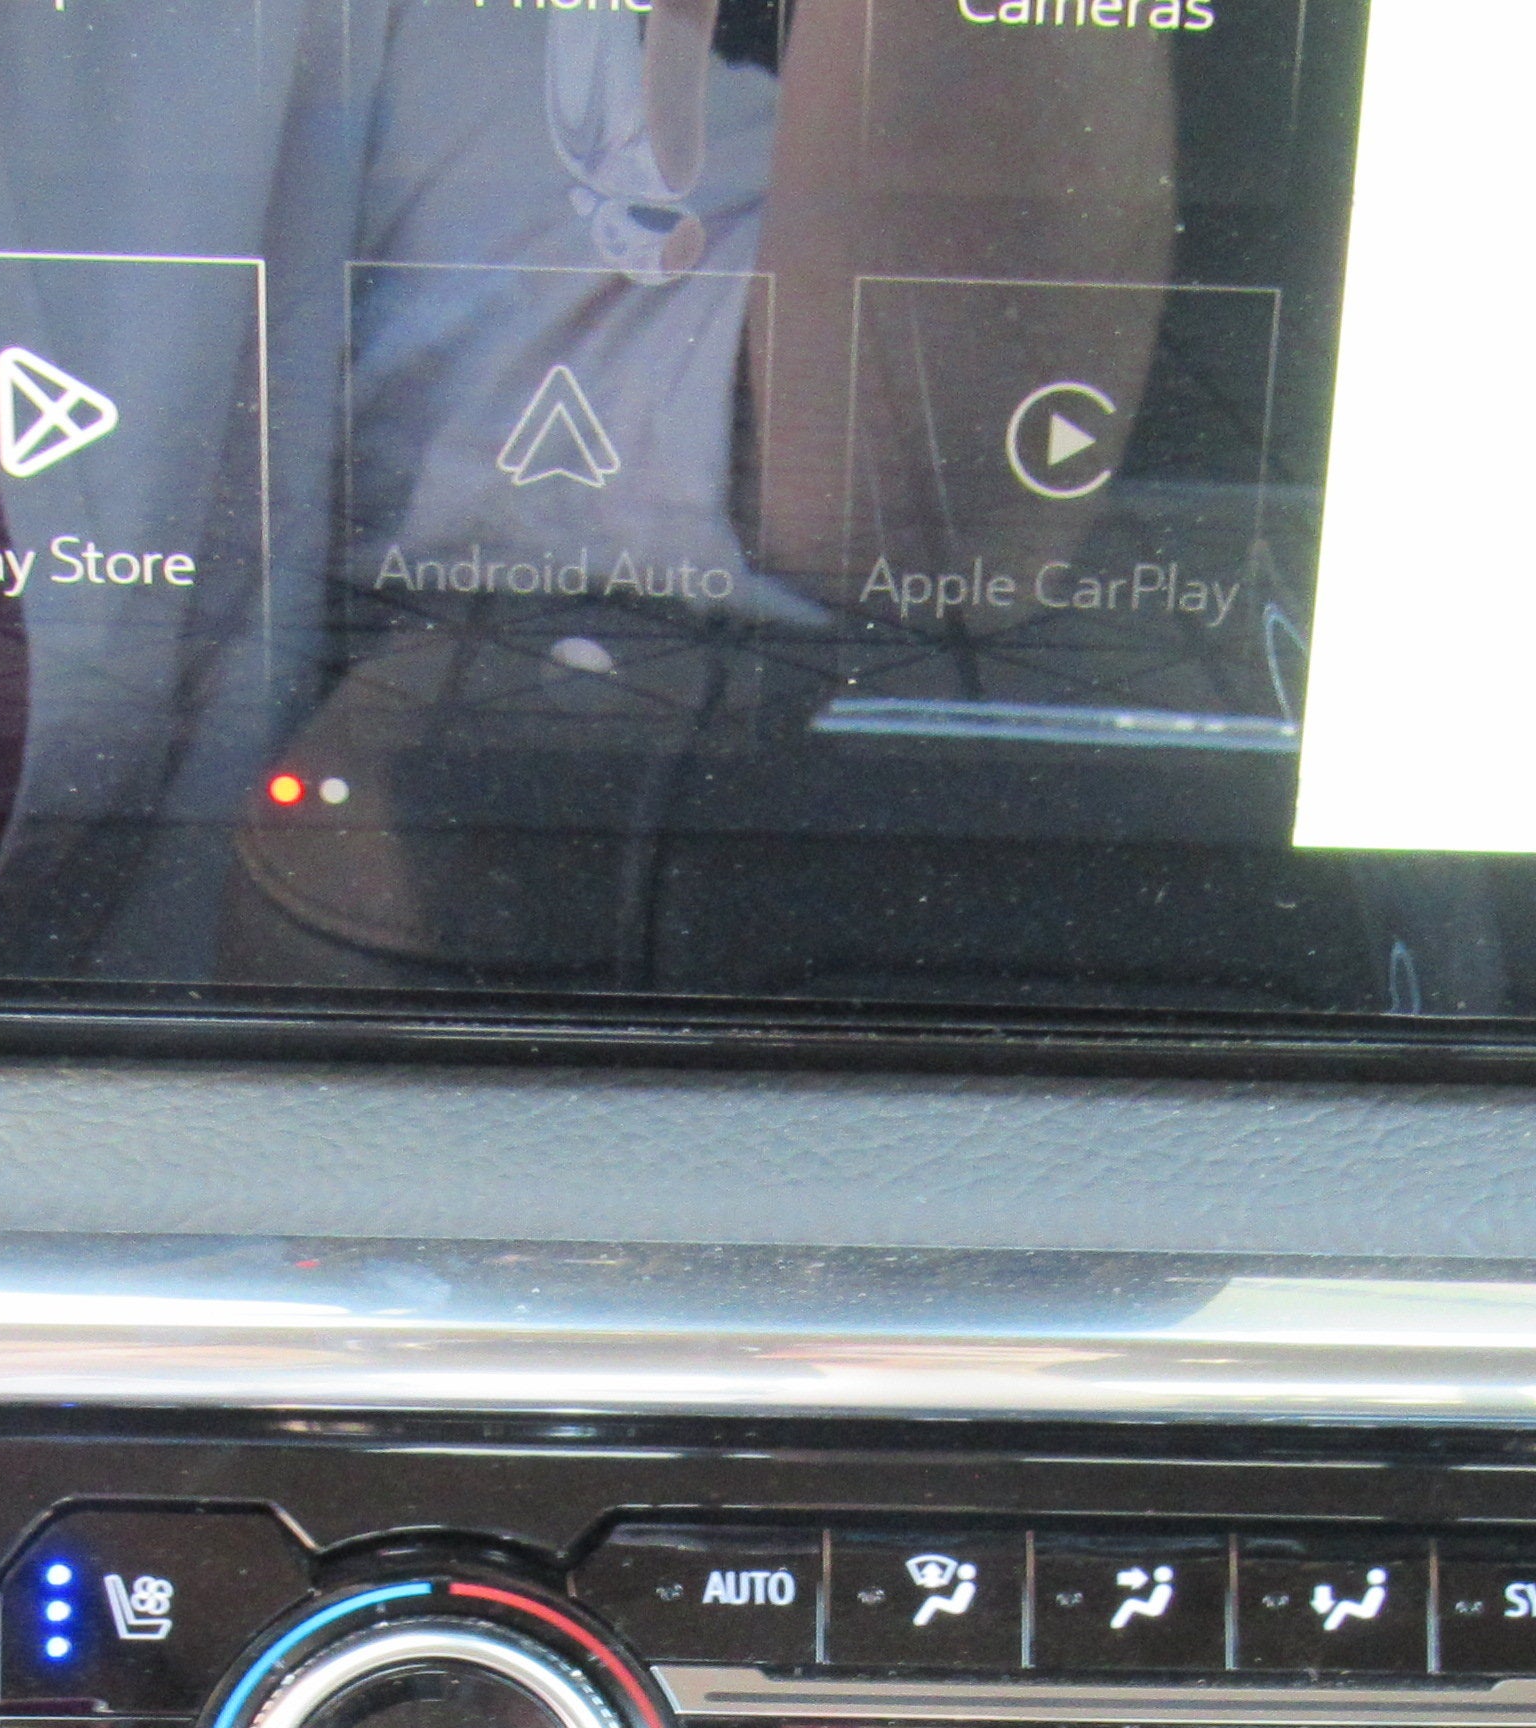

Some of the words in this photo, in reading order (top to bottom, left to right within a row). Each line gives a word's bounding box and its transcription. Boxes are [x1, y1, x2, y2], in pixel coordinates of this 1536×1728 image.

[49, 533, 197, 587] Store
[375, 546, 591, 596] Android
[604, 550, 735, 600] Auto
[858, 555, 1019, 620] Apple
[1032, 560, 1242, 622] CarPlay
[702, 1570, 796, 1606] AUTO
